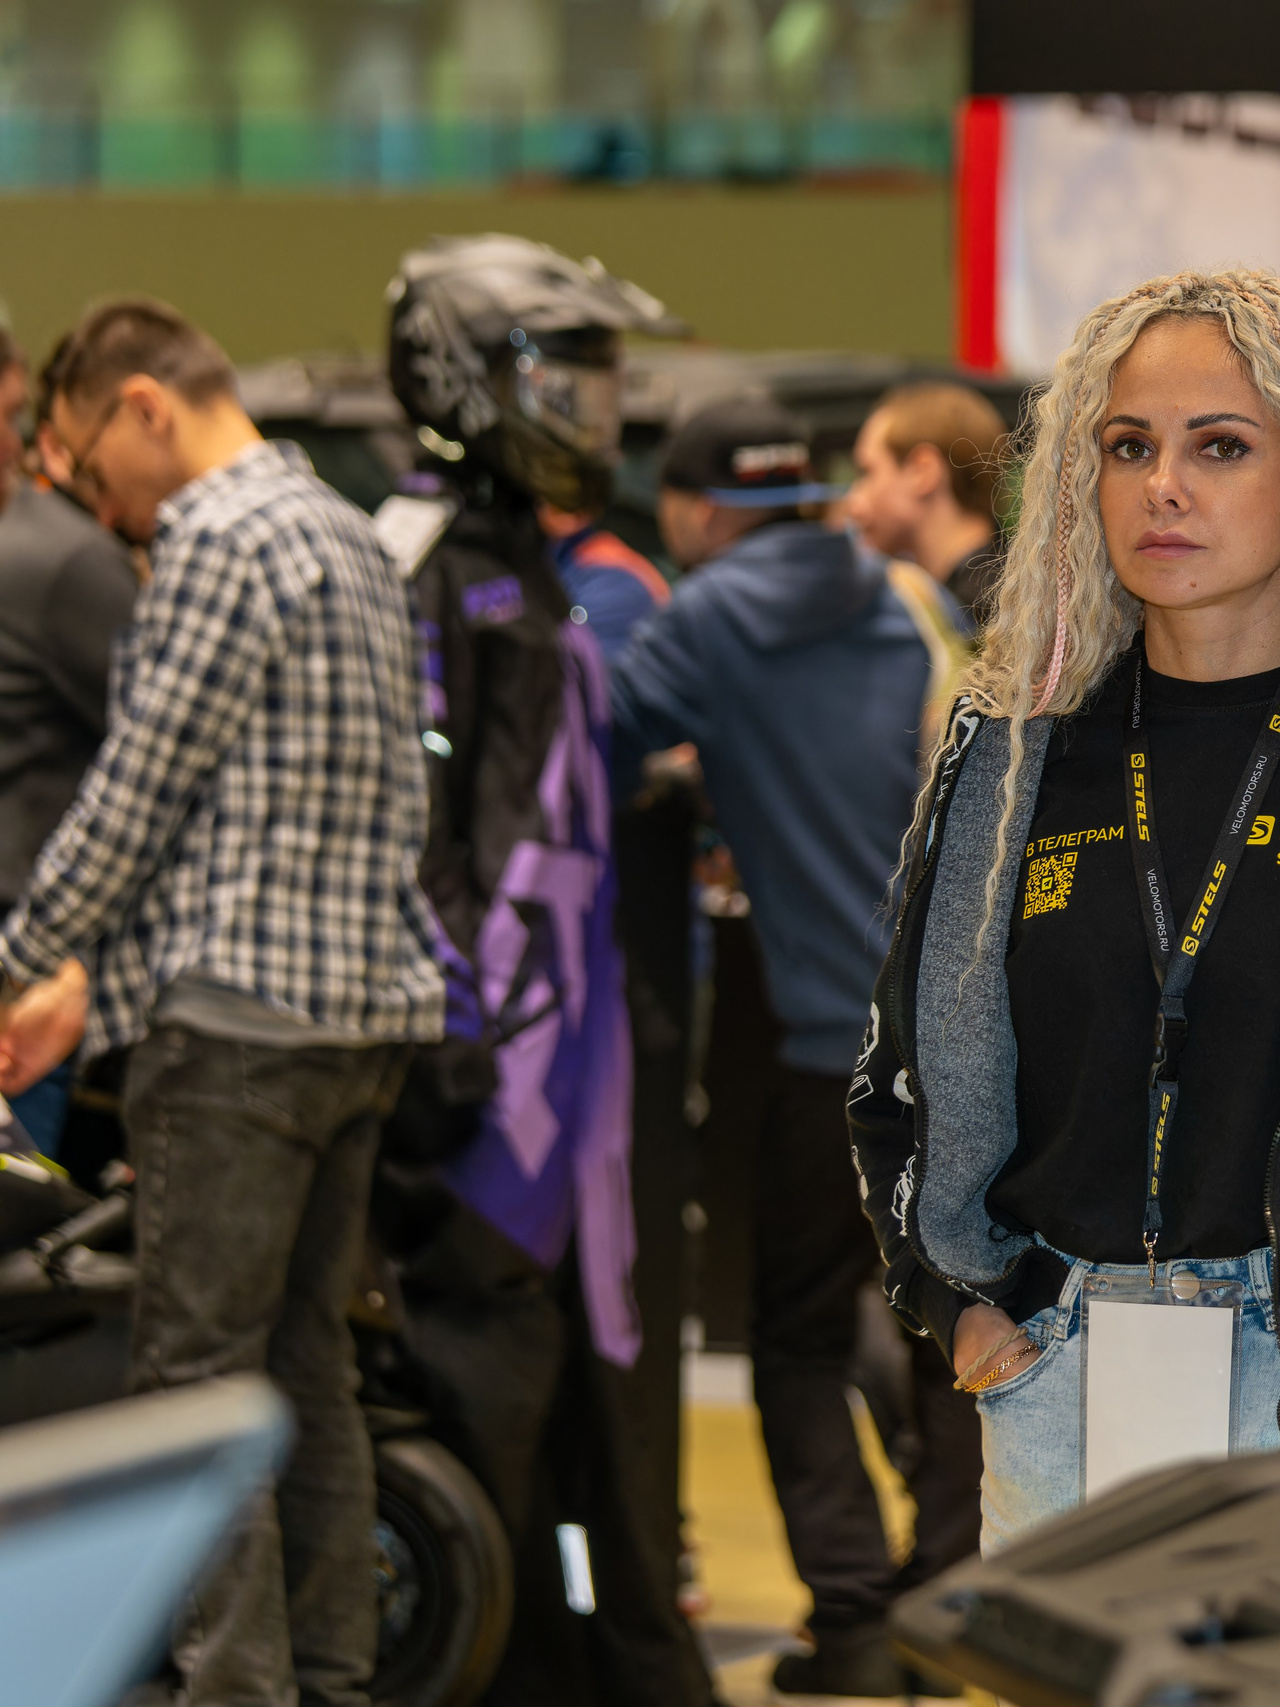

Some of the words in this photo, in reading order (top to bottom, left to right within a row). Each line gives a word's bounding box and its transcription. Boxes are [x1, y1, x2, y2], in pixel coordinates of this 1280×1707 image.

[1133, 771, 1150, 842] STELS
[1229, 755, 1268, 835] VELOMOTORS.RU
[1026, 842, 1035, 858] В
[1038, 825, 1125, 852] ТЕЛЕГРАМ
[1146, 868, 1170, 952] VELOMOTORS.RU
[1191, 859, 1227, 936] STELS
[1153, 1091, 1171, 1173] STELS
